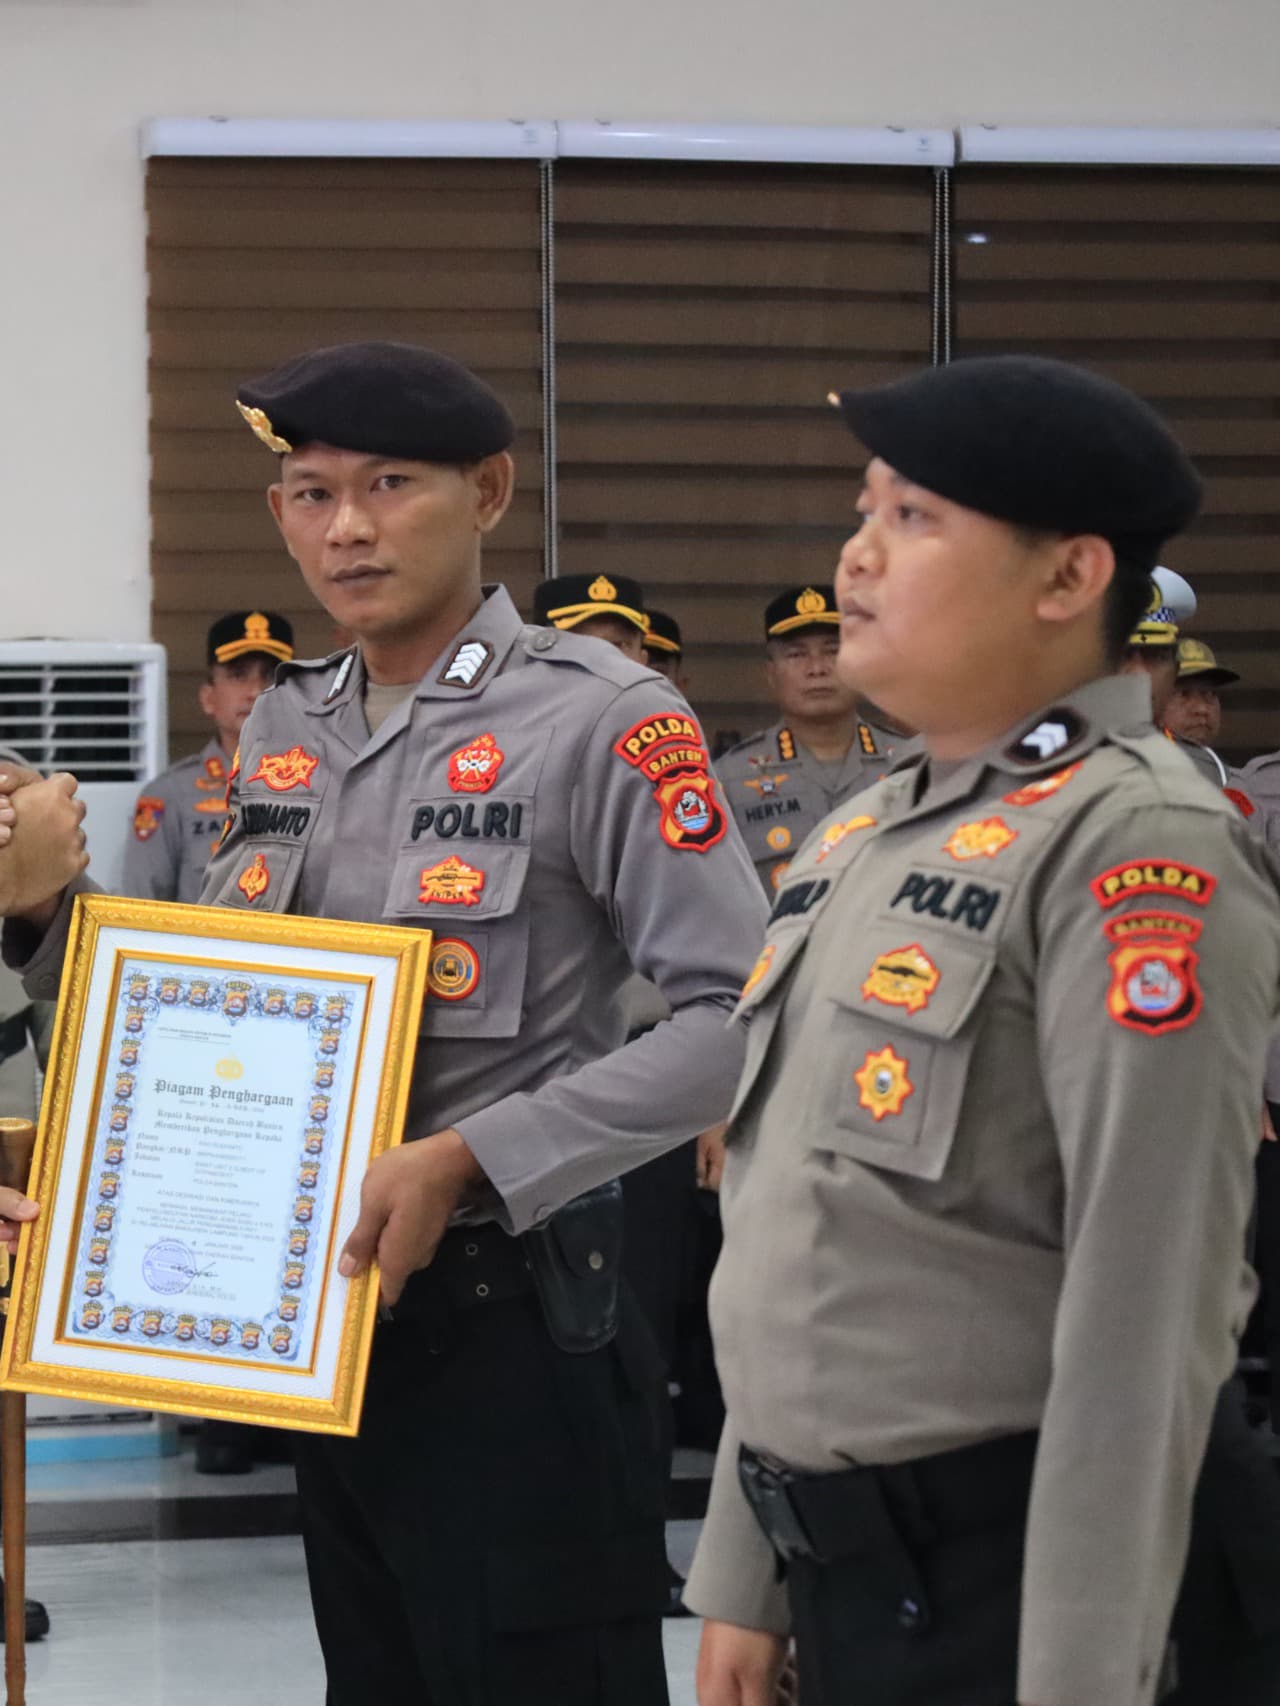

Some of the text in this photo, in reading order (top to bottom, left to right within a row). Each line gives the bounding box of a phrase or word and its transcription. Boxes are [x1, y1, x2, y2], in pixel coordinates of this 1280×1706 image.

[625, 718, 696, 756] POLDA
[648, 749, 702, 773] BANTEN
[411, 801, 523, 841] POLRI
[1103, 866, 1201, 896] POLDA
[890, 871, 1001, 931] POLRI
[153, 1077, 204, 1097] Piagam
[208, 1084, 294, 1107] Penghargaan
